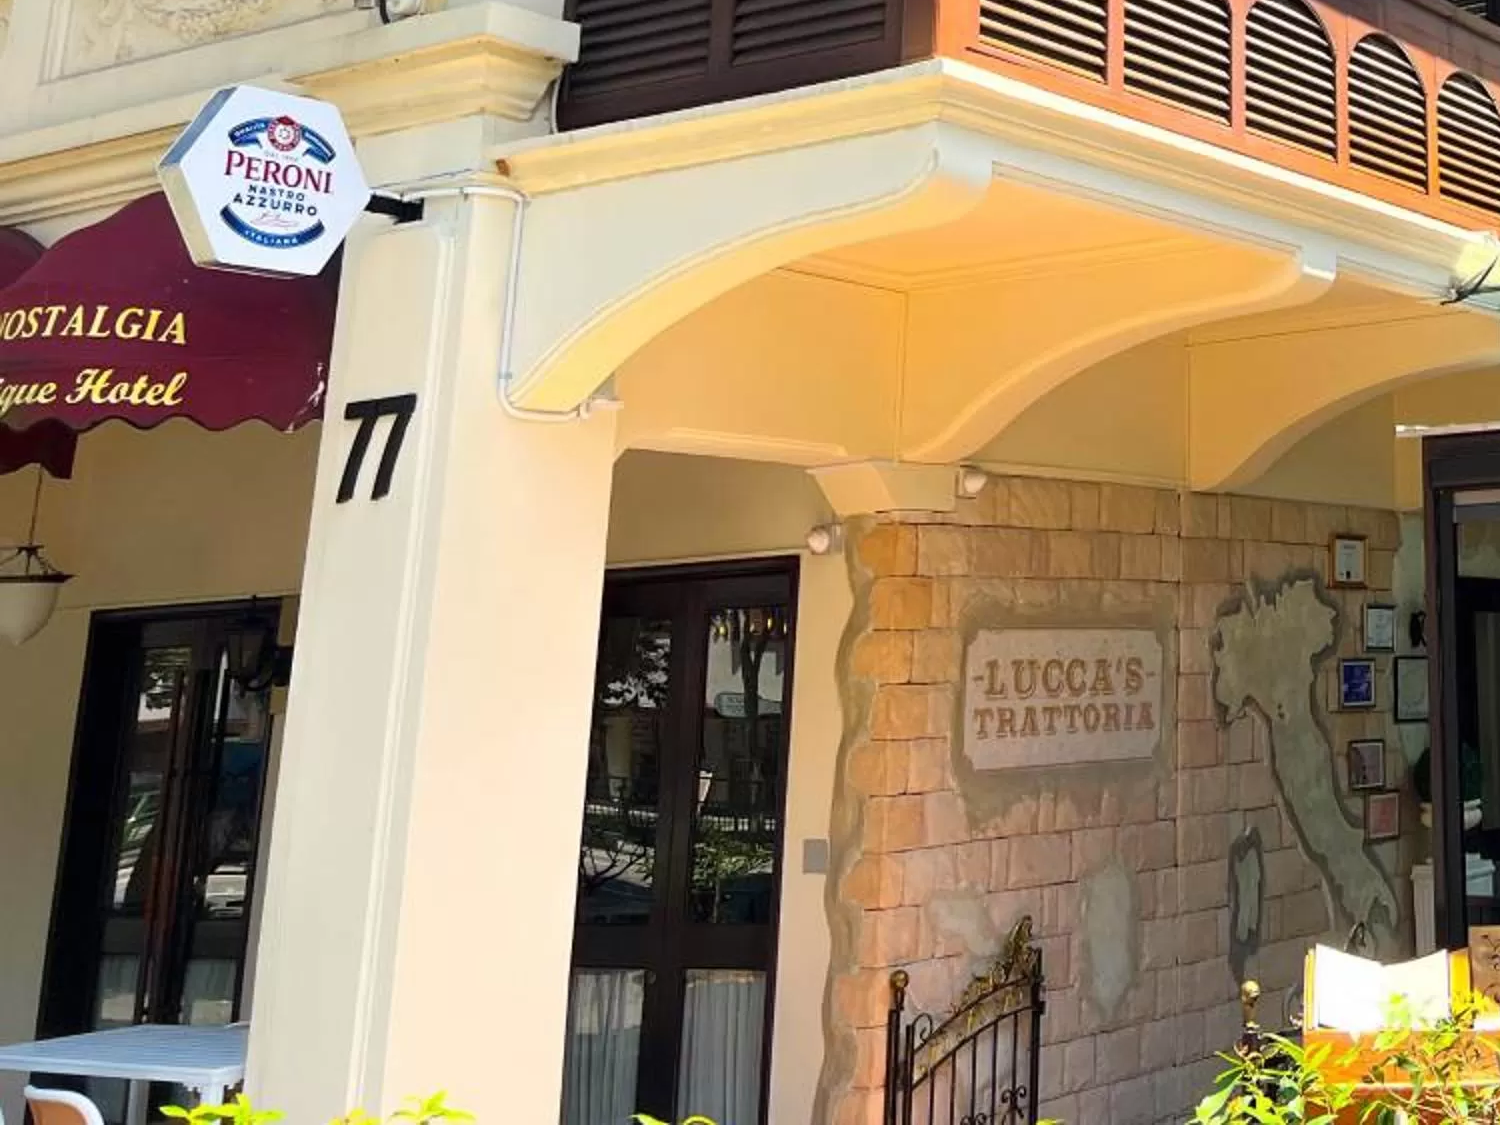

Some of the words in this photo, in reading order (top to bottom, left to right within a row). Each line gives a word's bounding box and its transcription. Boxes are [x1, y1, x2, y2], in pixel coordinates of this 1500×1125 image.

[224, 149, 334, 195] PERONI
[233, 193, 318, 217] AZZURRO
[248, 184, 305, 202] NASTRO
[64, 367, 188, 407] Hotel
[335, 393, 417, 504] 77
[983, 656, 1146, 700] LUCCA'S
[973, 701, 1155, 740] TRATTORIA
